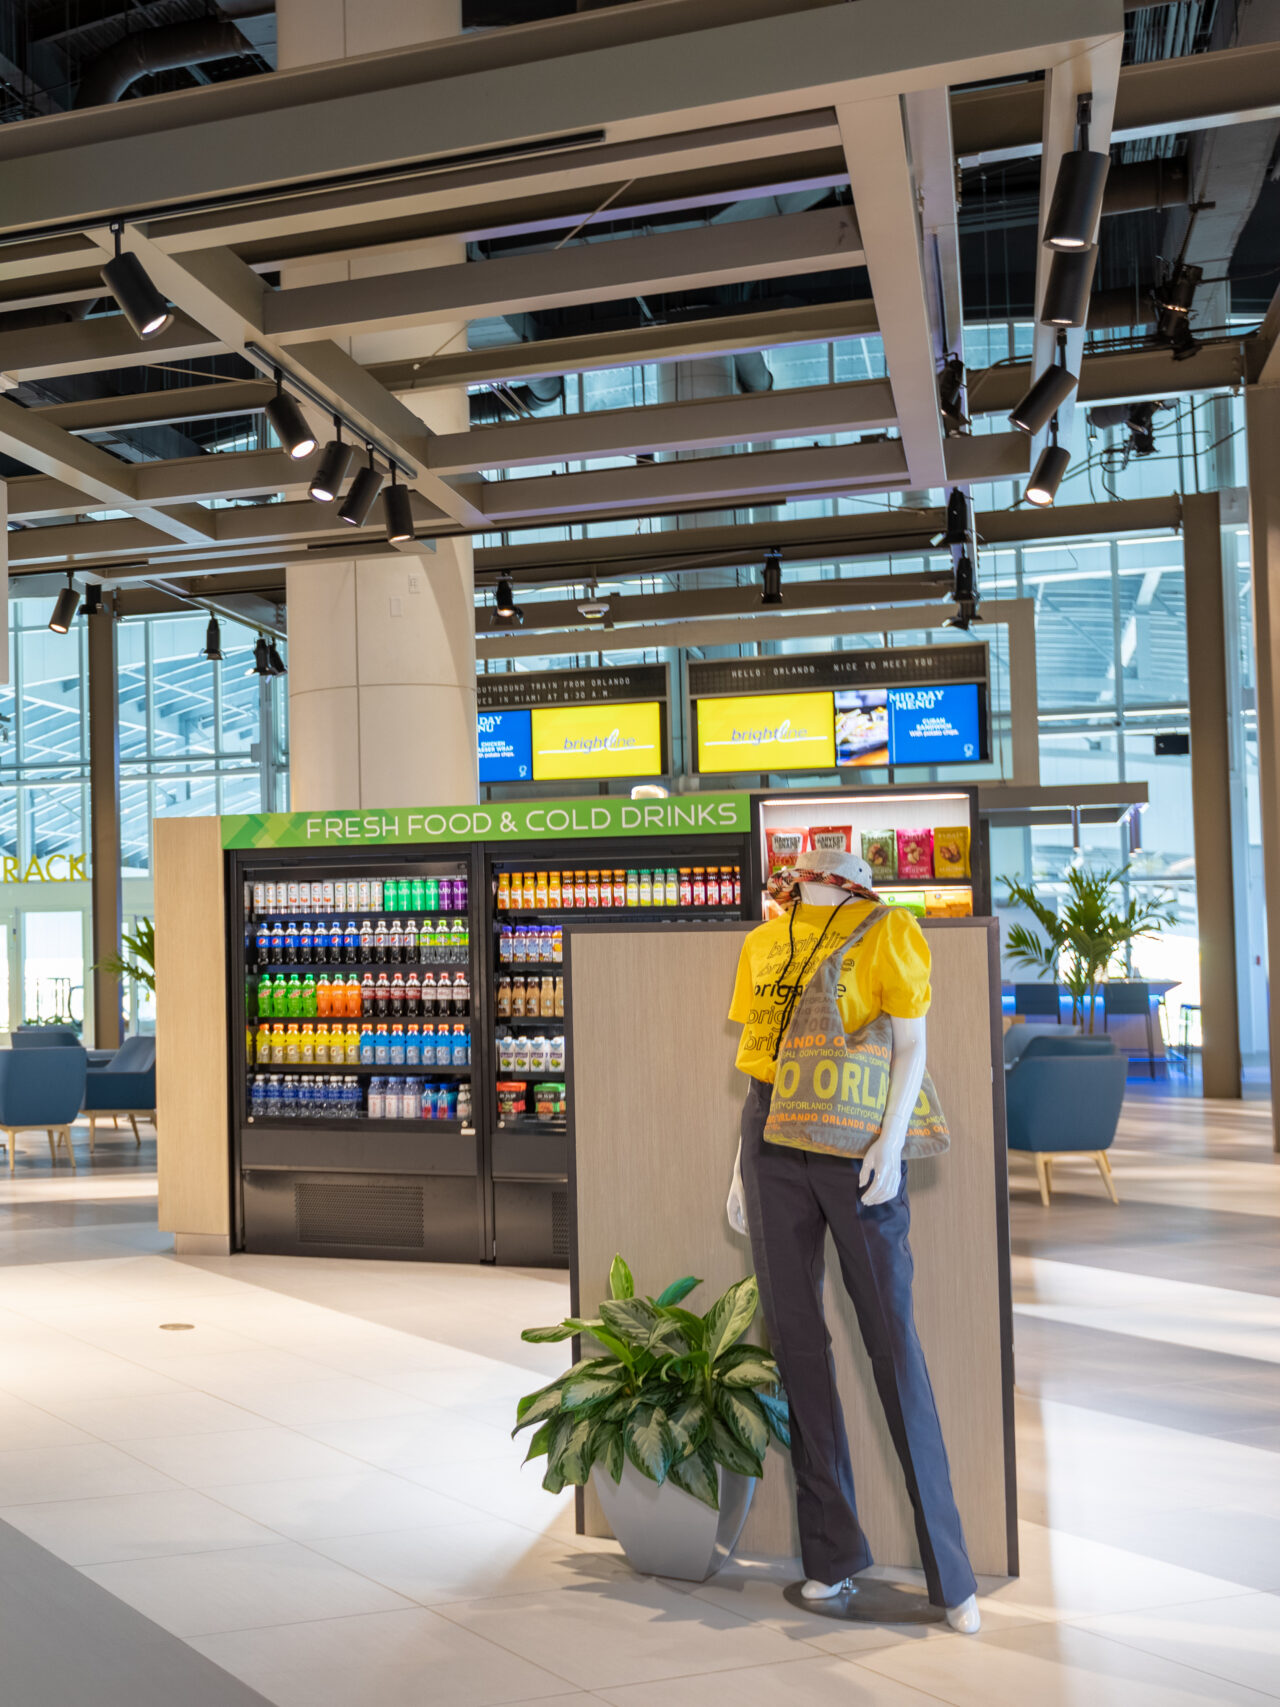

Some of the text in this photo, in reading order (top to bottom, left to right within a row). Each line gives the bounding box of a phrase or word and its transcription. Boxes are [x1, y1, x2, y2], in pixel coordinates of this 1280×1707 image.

[833, 662, 858, 672] NICE
[865, 661, 877, 670] TO
[882, 658, 907, 668] MEET
[477, 677, 630, 694] OUTHBOUND TRAIN FROM ORLANDO
[515, 694, 540, 702] MIAMI
[889, 690, 944, 703] MID DAY
[895, 699, 935, 710] MENU
[479, 716, 502, 725] DAY
[478, 724, 494, 733] NU
[732, 719, 808, 746] brightline
[563, 728, 636, 755] brightline
[307, 803, 737, 839] FRESH FOOD & COLD DRINKS
[822, 1114, 864, 1130] ORLANDO
